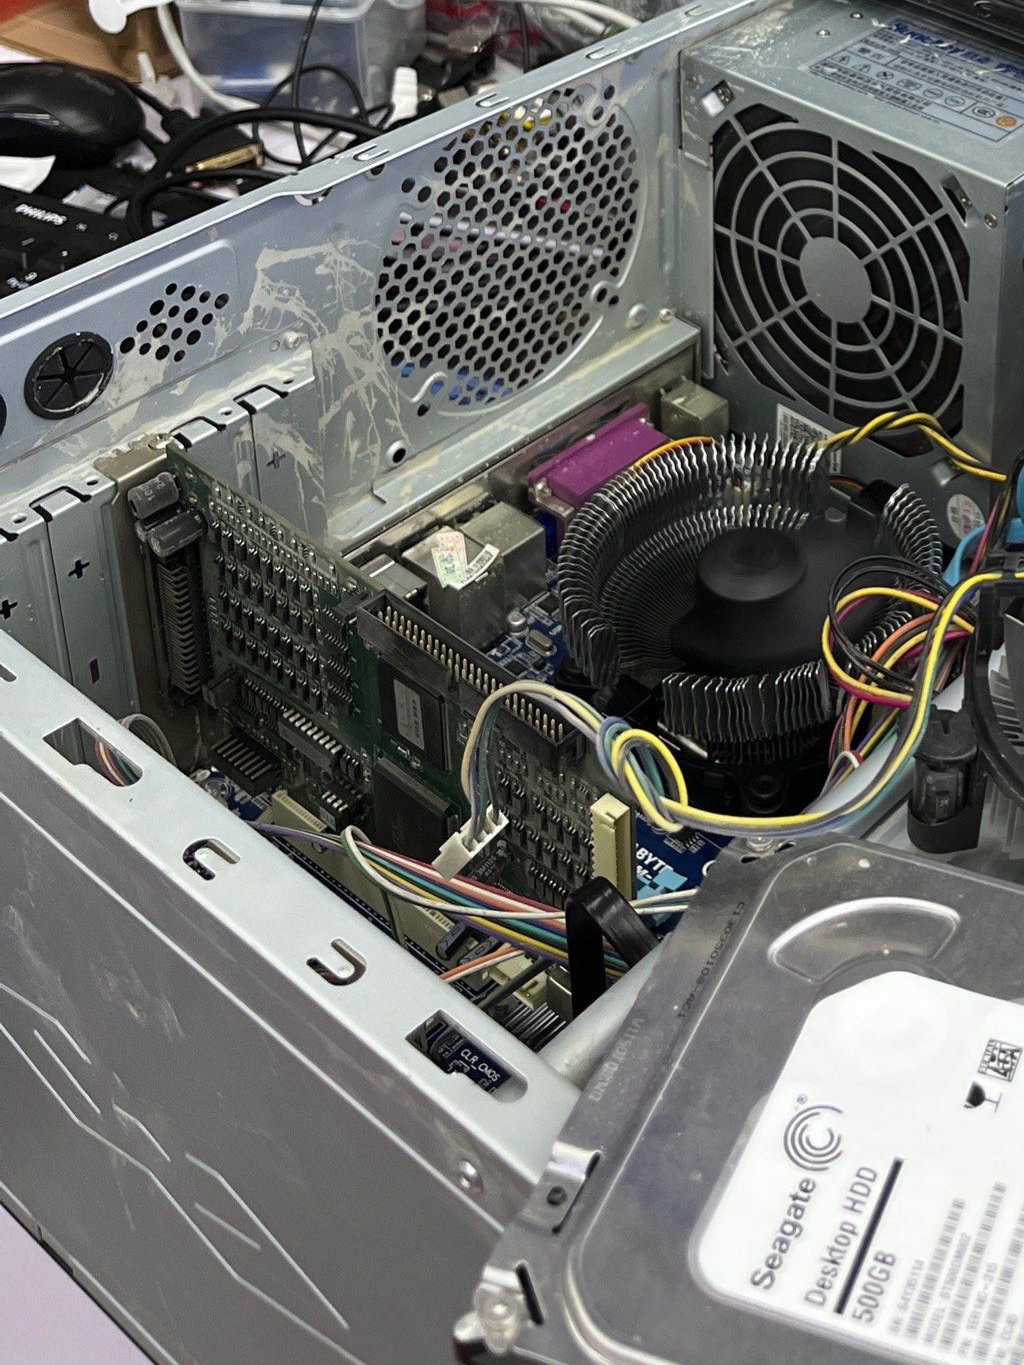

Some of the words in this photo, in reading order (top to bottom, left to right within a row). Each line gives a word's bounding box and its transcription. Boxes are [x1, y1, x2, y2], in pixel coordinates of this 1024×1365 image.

[461, 1048, 501, 1082] CLR_CMOS
[750, 1177, 817, 1292] Seagate
[803, 1221, 859, 1308] Desktop
[843, 1165, 878, 1214] HDD
[852, 1249, 897, 1323] 500GB
